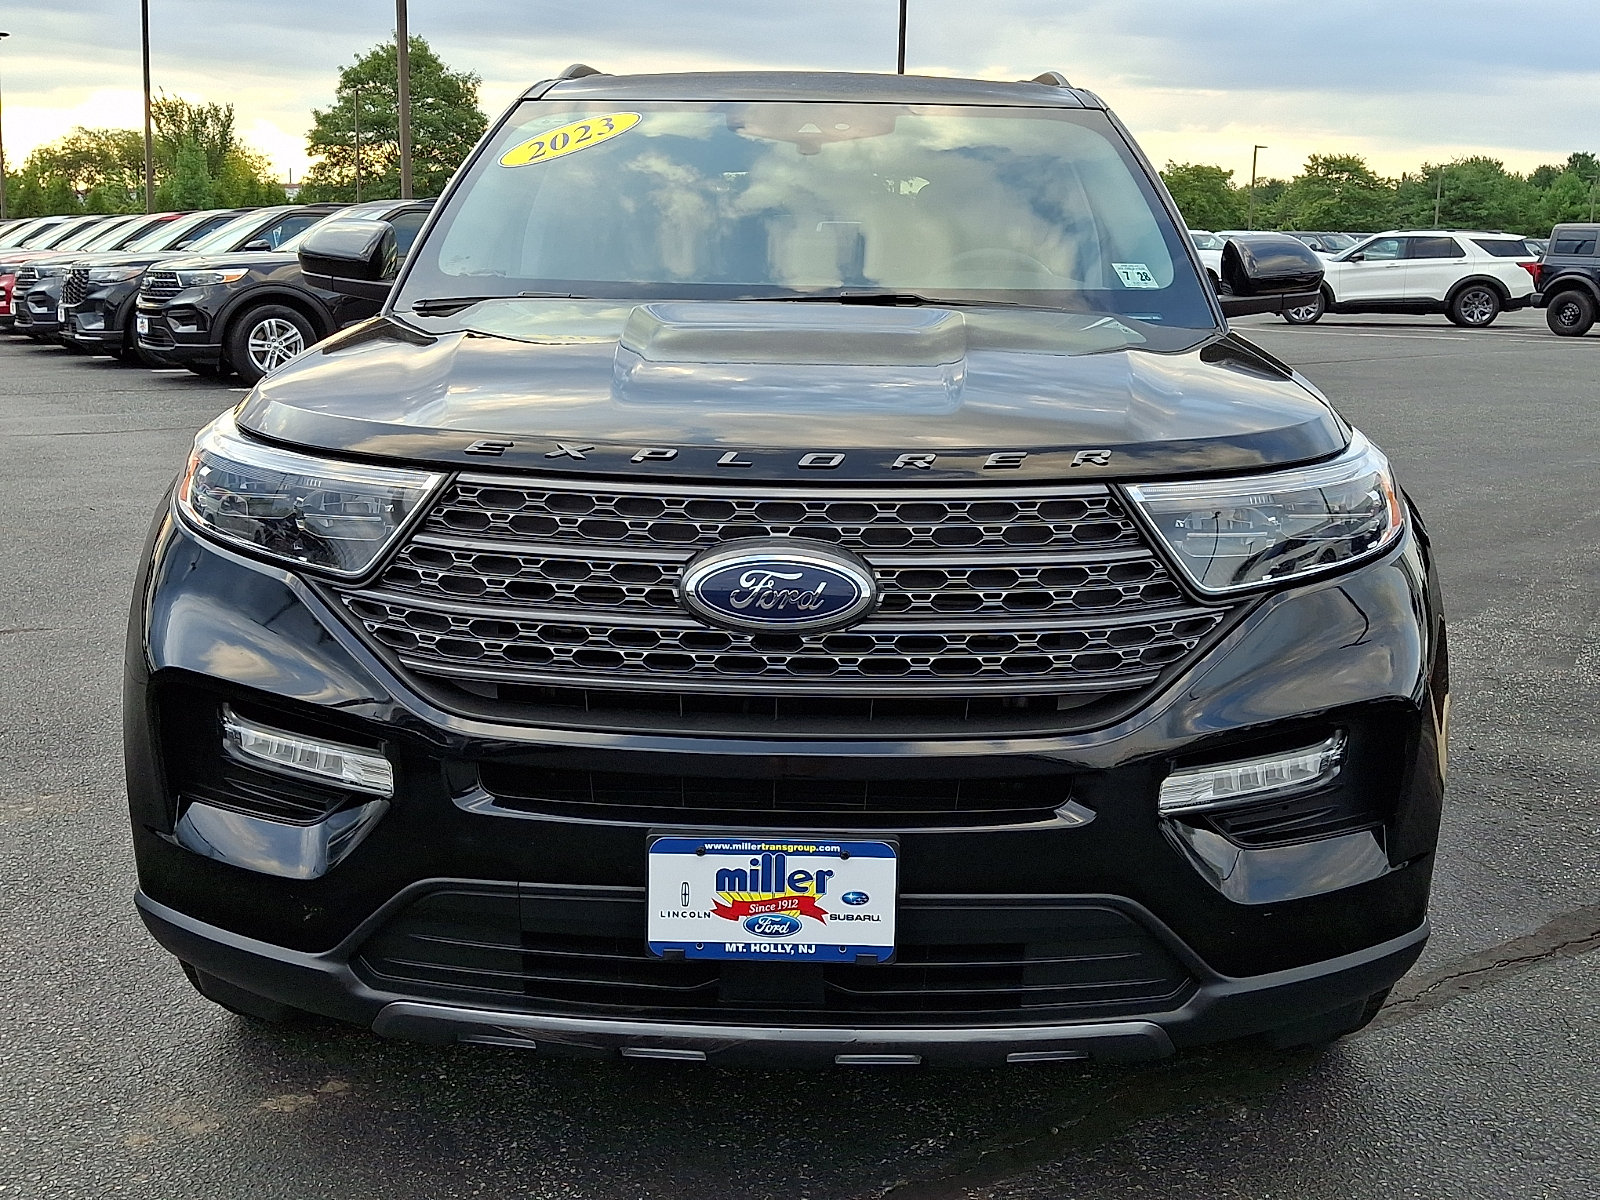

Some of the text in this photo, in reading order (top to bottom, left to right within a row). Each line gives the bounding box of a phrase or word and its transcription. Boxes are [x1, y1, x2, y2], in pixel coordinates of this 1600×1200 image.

[527, 117, 615, 161] 2023
[1122, 271, 1151, 281] 7 28
[463, 439, 1113, 470] EXPLORER
[729, 569, 828, 611] Ford
[704, 842, 841, 853] www.millertransgroup.com
[715, 852, 834, 893] miller
[748, 898, 799, 914] Since 1912
[660, 910, 711, 919] LINCOLN
[829, 913, 880, 922] SUBARU
[754, 915, 790, 934] Ford
[725, 942, 816, 955] MT. HOLLY, NJ
